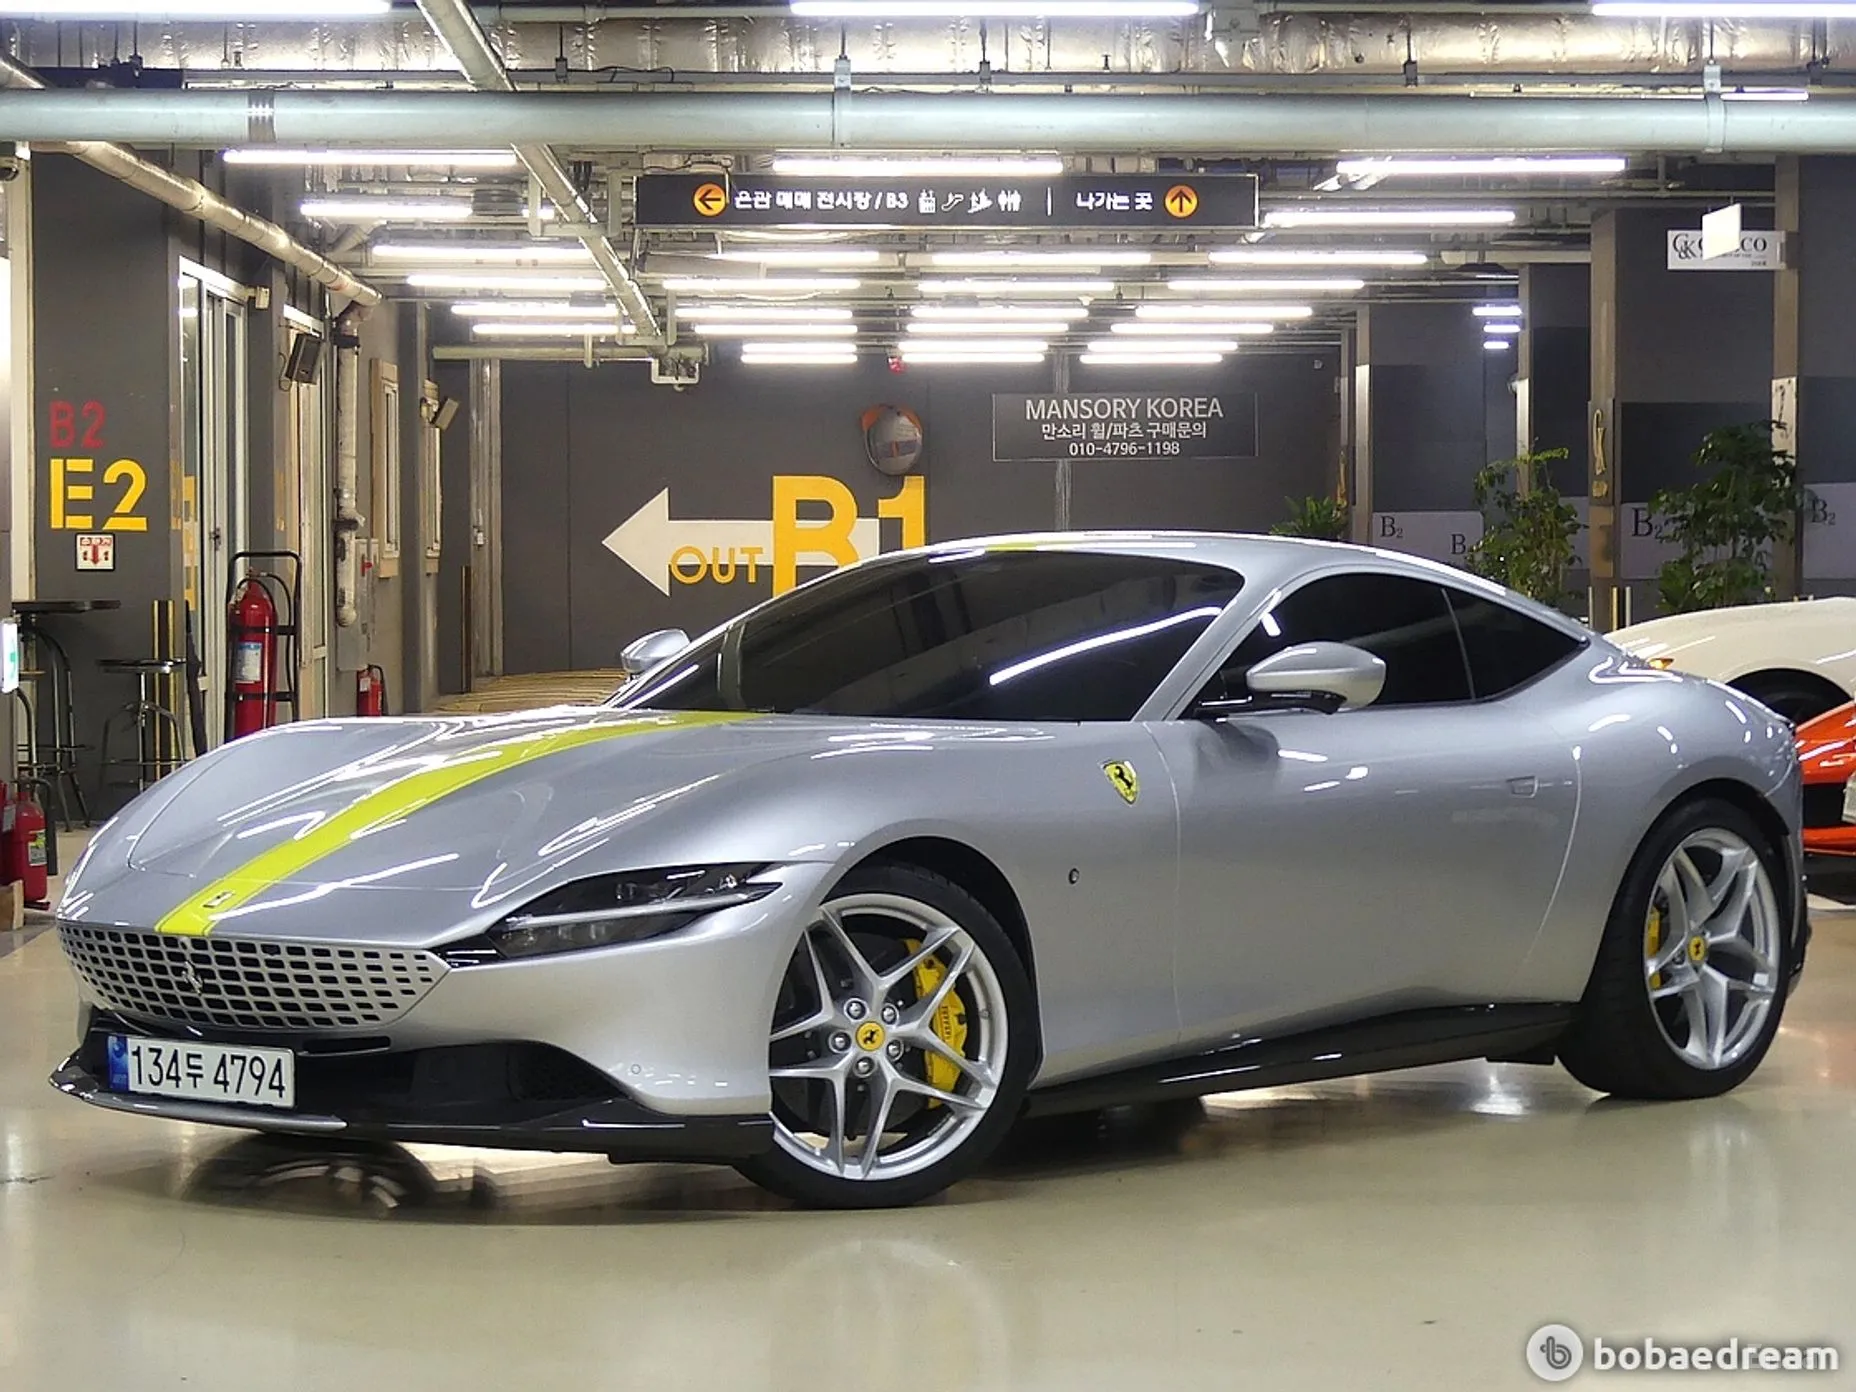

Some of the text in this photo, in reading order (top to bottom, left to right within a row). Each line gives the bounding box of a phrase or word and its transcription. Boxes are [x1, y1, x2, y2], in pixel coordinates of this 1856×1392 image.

[1076, 191, 1153, 210] 나가는 곳
[1025, 397, 1224, 420] MANSORY KOREA
[49, 400, 107, 449] B2
[1041, 421, 1087, 441] 만소리
[1146, 420, 1208, 439] 구매문의
[1069, 441, 1181, 456] 010-4796-1198
[49, 458, 148, 531] E2
[669, 545, 764, 585] OUT
[131, 1045, 286, 1099] 134두 4794
